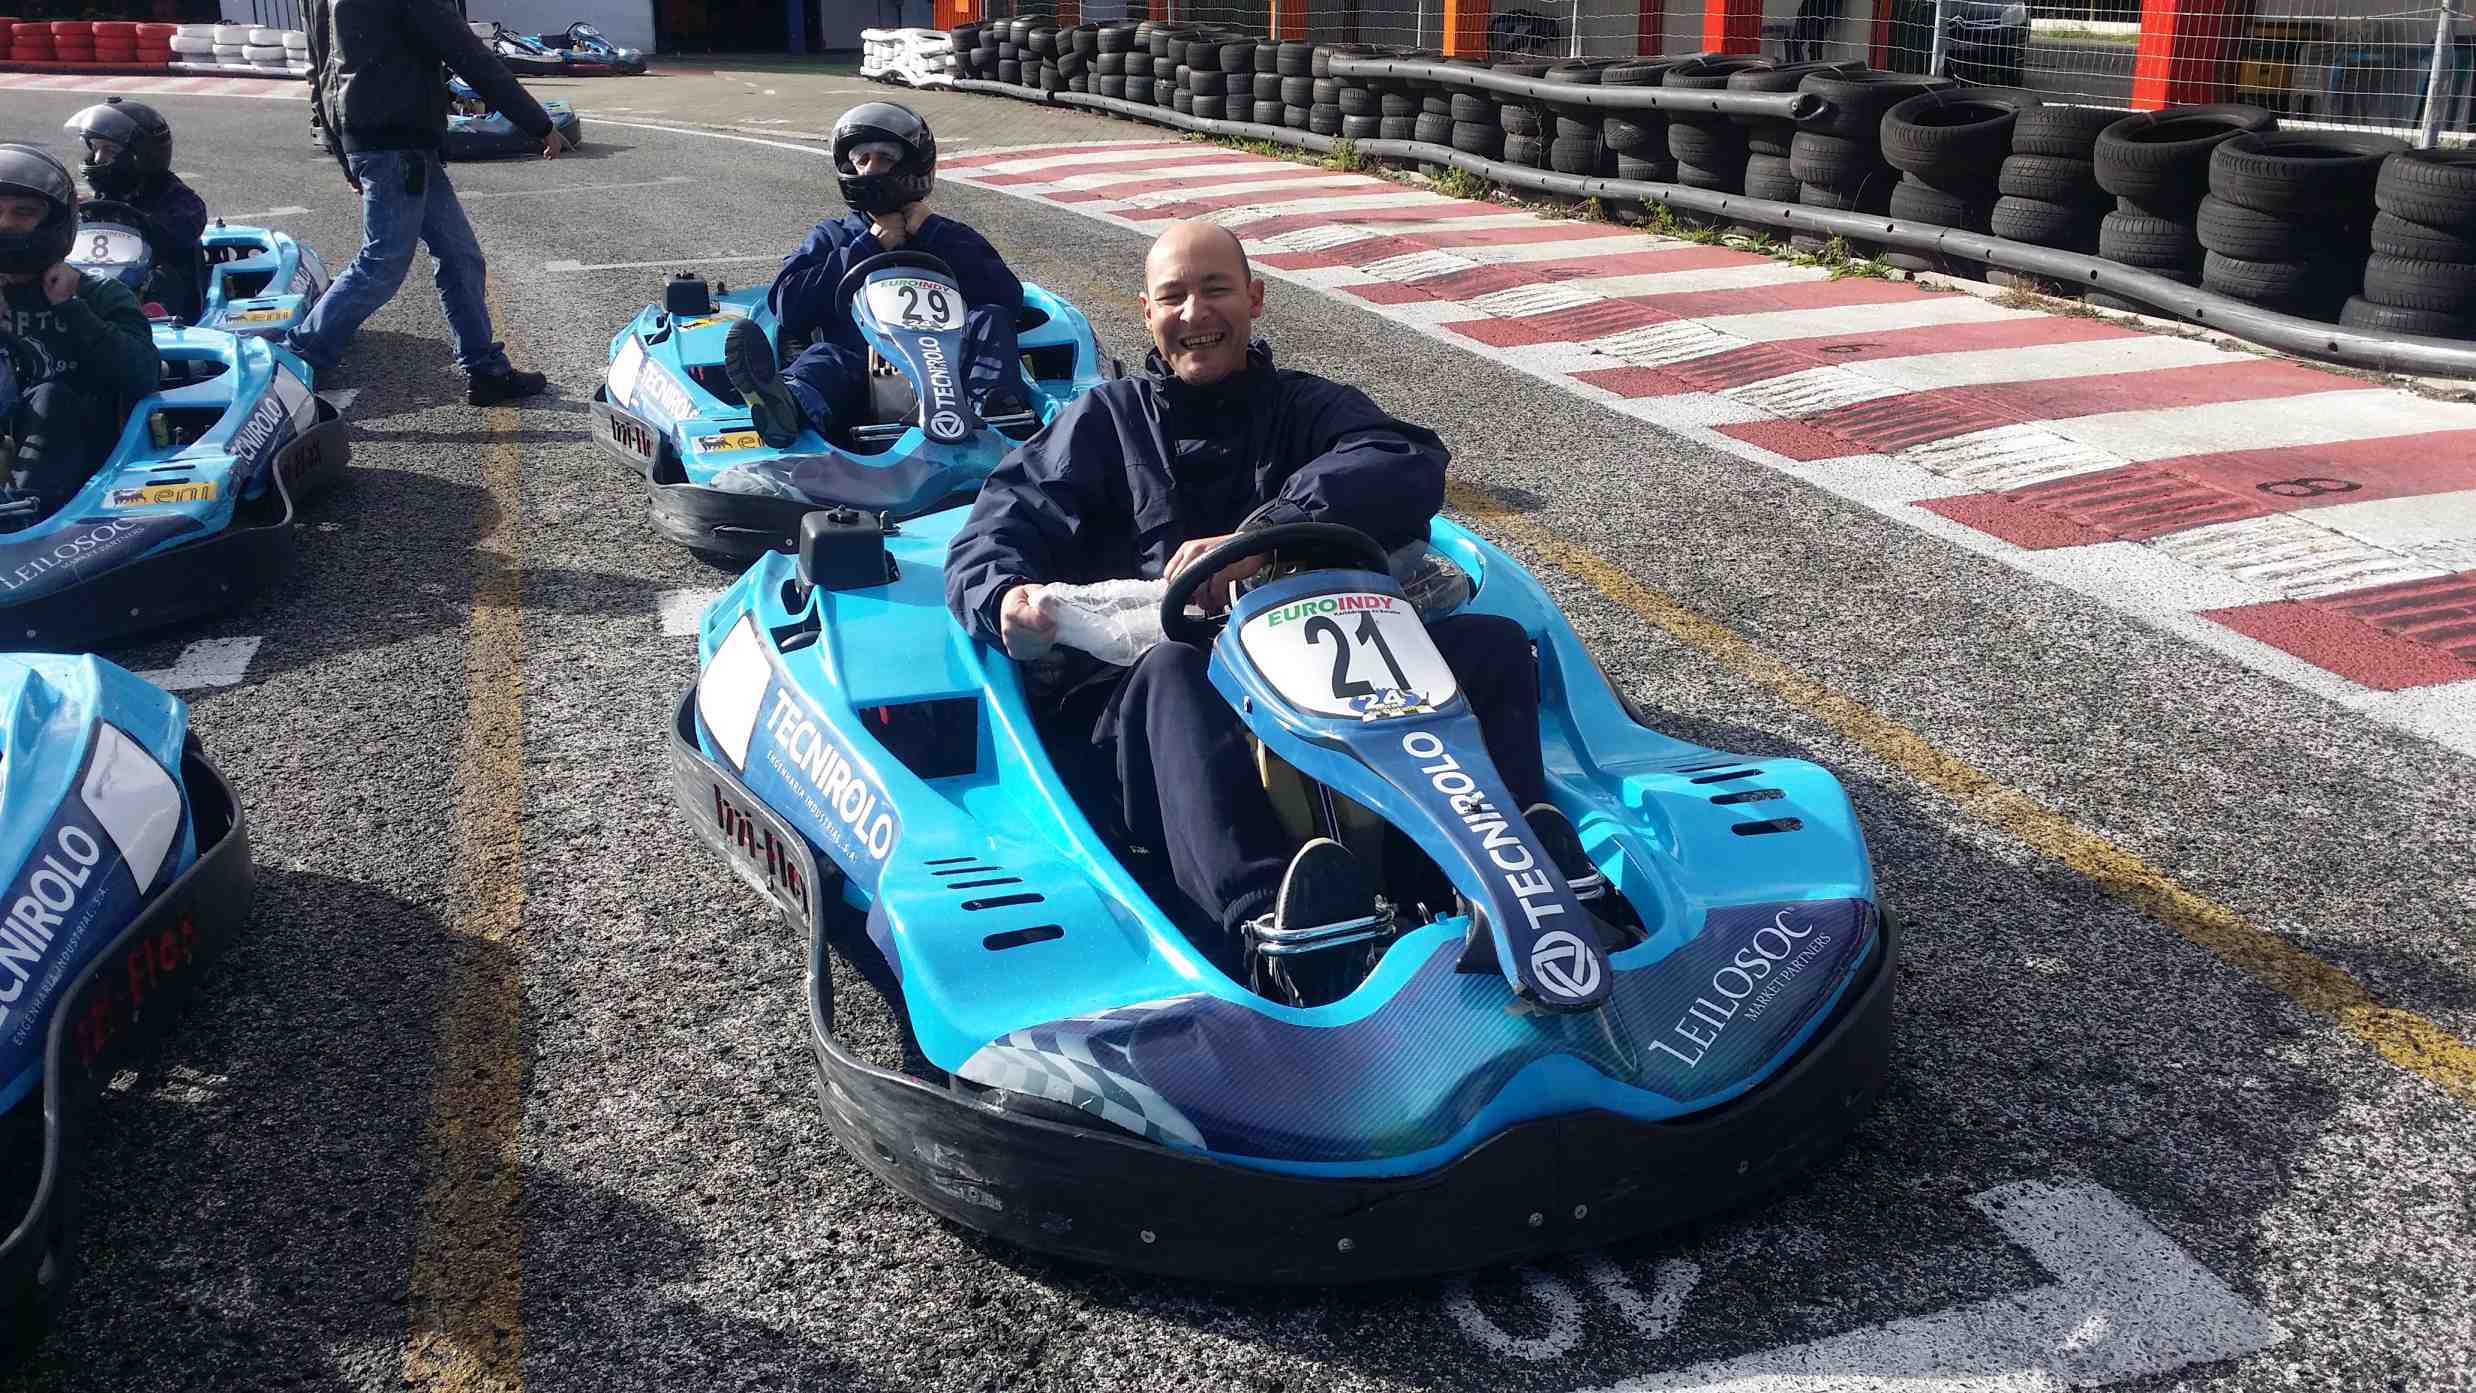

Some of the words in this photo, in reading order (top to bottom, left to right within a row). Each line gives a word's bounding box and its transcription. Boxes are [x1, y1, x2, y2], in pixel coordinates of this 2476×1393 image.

[91, 234, 109, 258] 8
[898, 286, 950, 323] 29
[918, 336, 956, 410] TECNIROLO
[153, 485, 209, 503] eni
[0, 521, 137, 590] LEILOSOC
[1267, 596, 1393, 627] EUROINDY
[1305, 612, 1413, 699] 21
[767, 688, 893, 860] TECNIROLO
[1402, 731, 1565, 930] TECNIROLO
[1648, 909, 1813, 1069] LEILOSOC
[1744, 977, 1786, 1022] MARKET
[1780, 933, 1832, 983] PARTNERS
